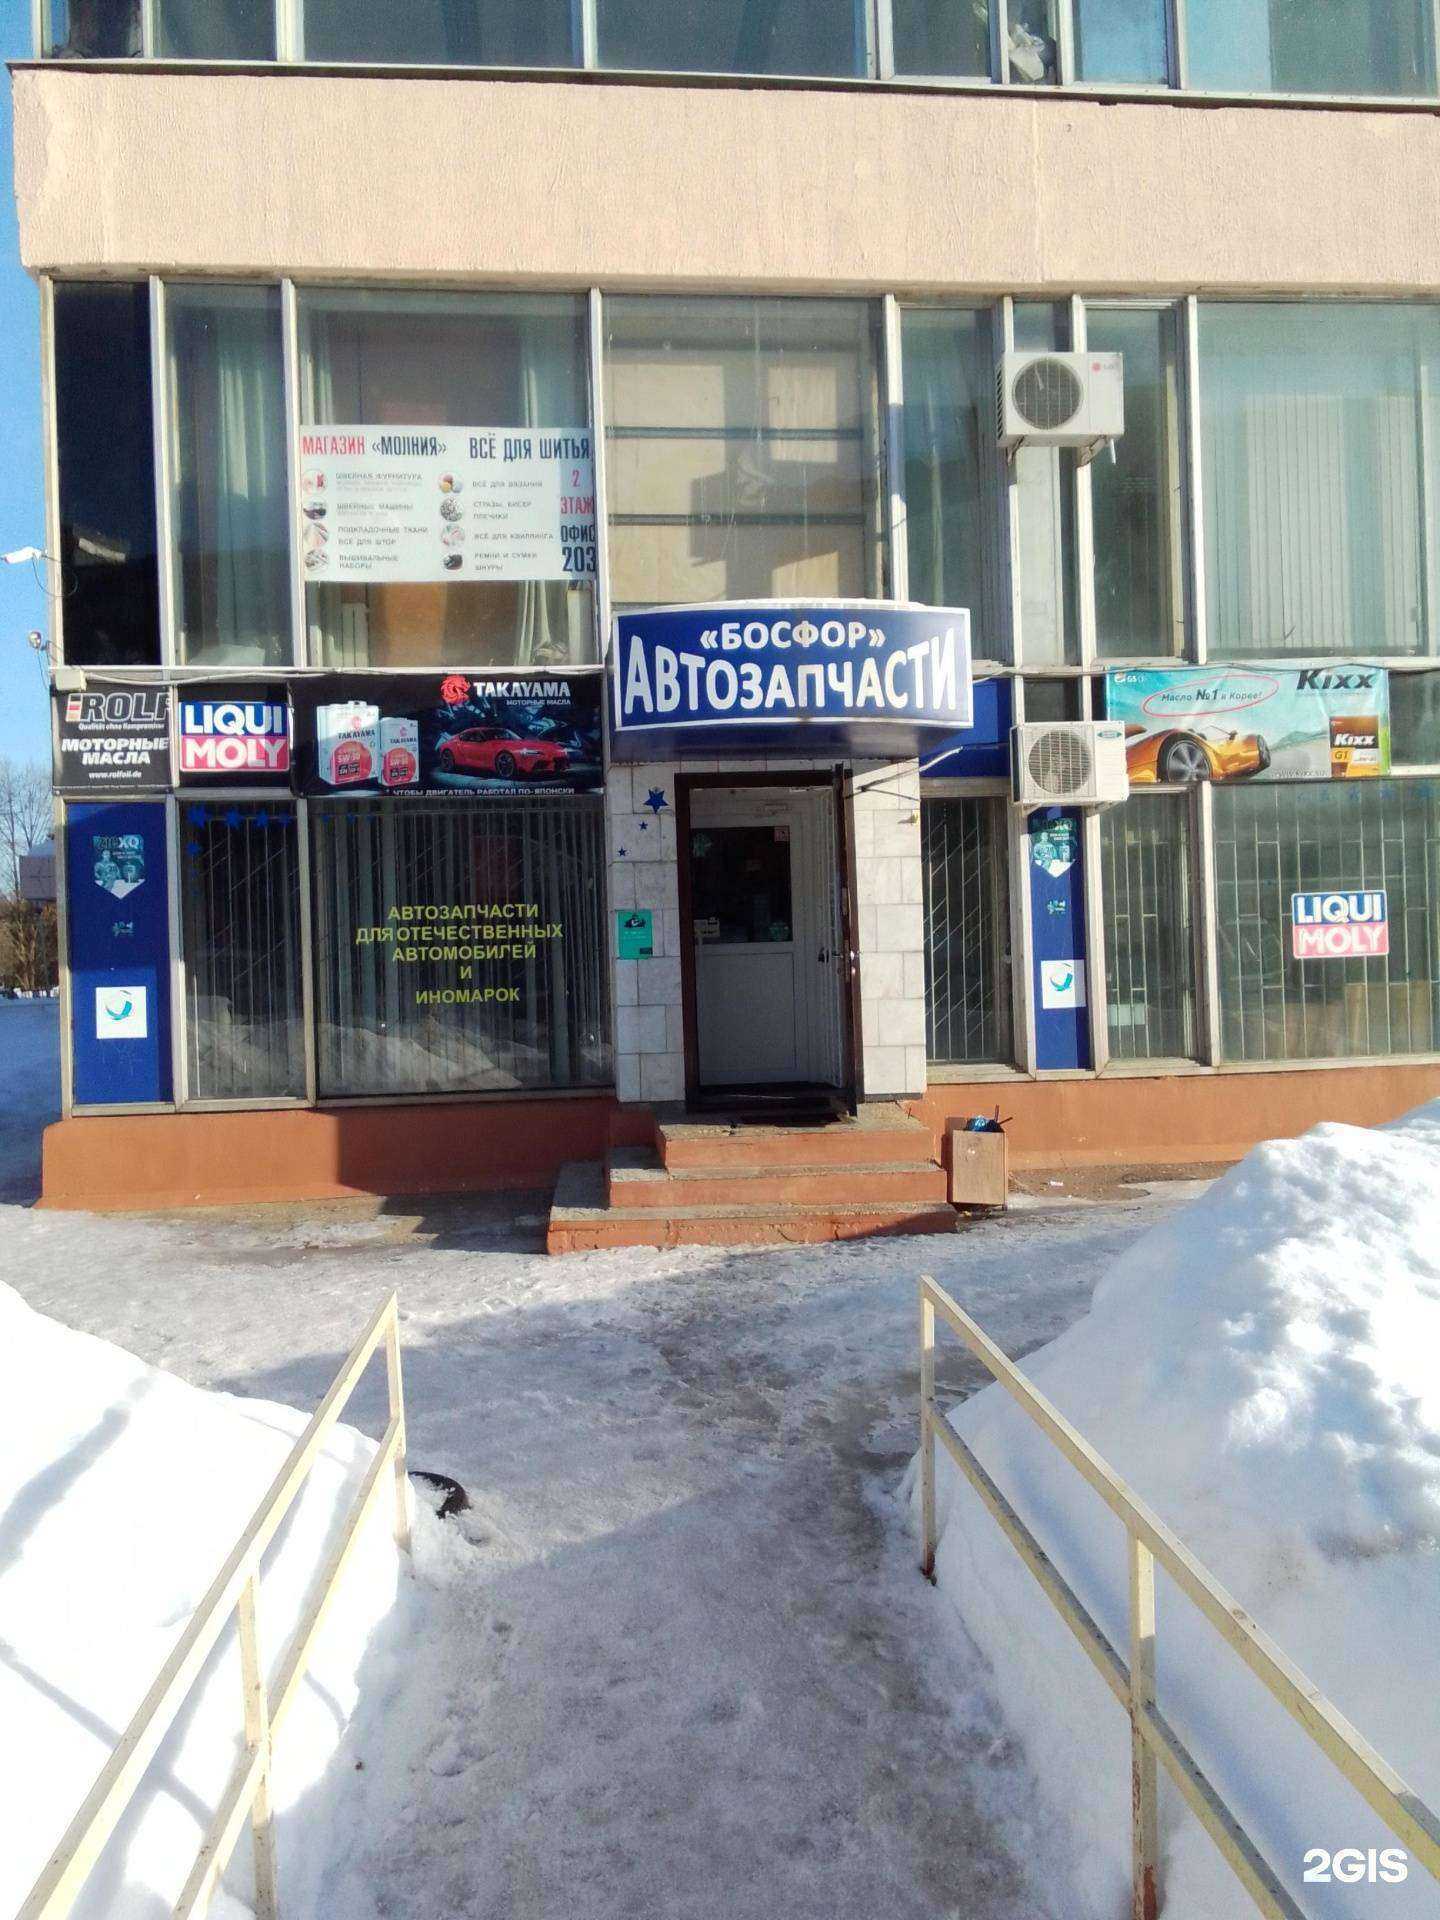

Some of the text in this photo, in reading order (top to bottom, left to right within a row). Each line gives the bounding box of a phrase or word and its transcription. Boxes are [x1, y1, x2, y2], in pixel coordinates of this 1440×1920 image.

[302, 435, 365, 456] МАГАЗИН
[470, 433, 589, 462] ВСЁ ДЛЯ ШИТЬЯ
[572, 470, 581, 487] 2
[560, 496, 594, 514] ЭТАЖ
[561, 525, 595, 542] ОФИС
[562, 546, 596, 572] 203
[700, 620, 886, 650] «БОСФОР»
[625, 627, 957, 714] АВТОЗАПЧАСТИ
[473, 682, 571, 698] TAKAYAMA
[1162, 694, 1192, 702] Масло
[185, 704, 282, 736] LIQUI
[61, 738, 169, 751] МОТОРНЫЕ
[185, 738, 286, 768] MOLY
[82, 751, 150, 765] МАСЛА
[388, 904, 539, 921] АВТОЗАПЧАСТИ
[1297, 894, 1382, 923] LIQUI
[356, 924, 563, 945] ДЛЯ ОТЕЧЕСТВЕННЫХ
[1298, 926, 1384, 955] MOLY
[460, 966, 472, 979] И
[416, 988, 520, 1004] ИНОМАРОК
